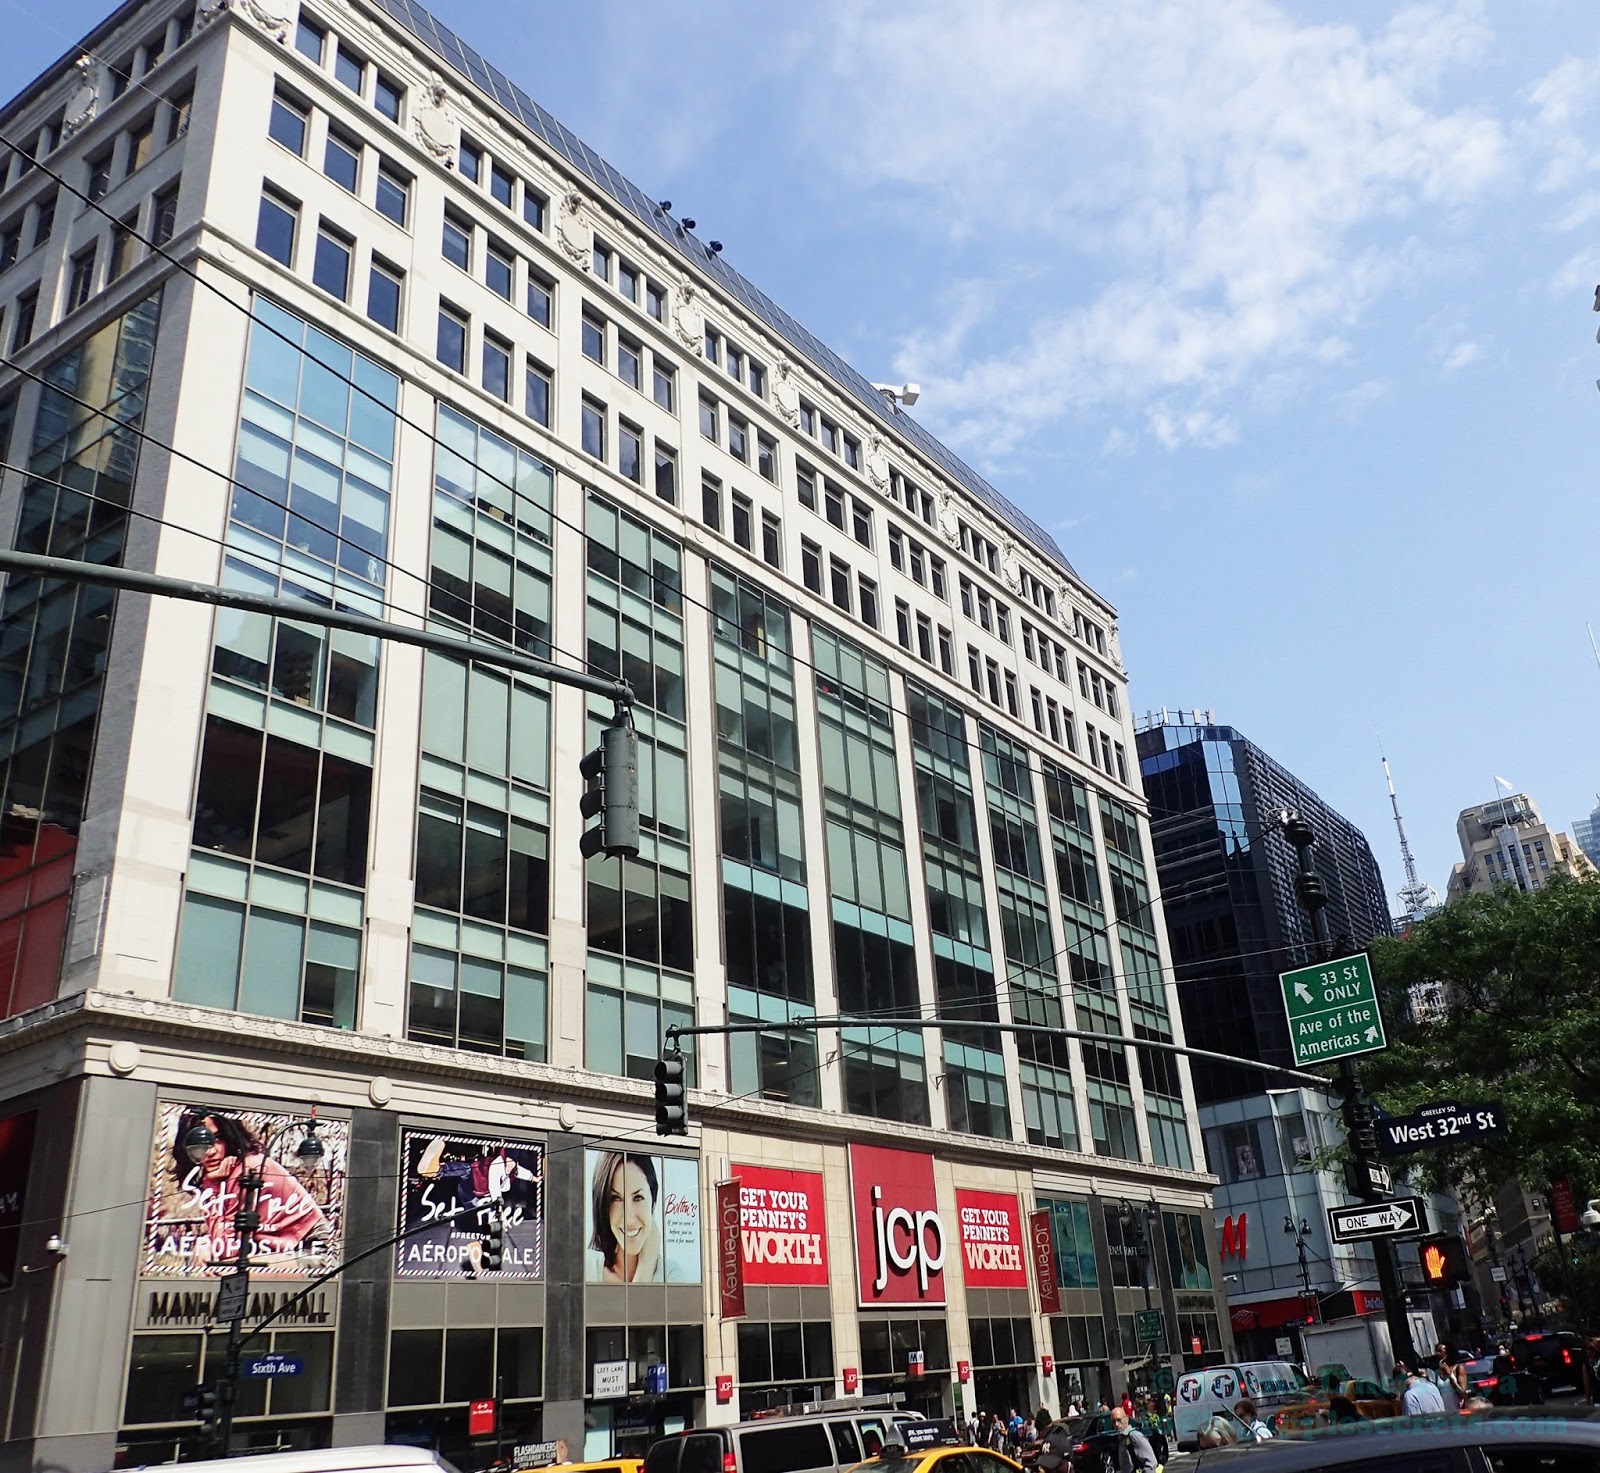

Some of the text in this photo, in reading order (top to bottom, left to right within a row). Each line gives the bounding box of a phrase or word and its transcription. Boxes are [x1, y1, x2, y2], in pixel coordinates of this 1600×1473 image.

[1320, 965, 1359, 986] 33 St
[1324, 982, 1360, 1002] ONLY
[1299, 1009, 1371, 1036] Ave of the
[1299, 1033, 1360, 1057] Americas
[1421, 1105, 1456, 1116] GREELEY SQ
[1389, 1111, 1497, 1144] West 32nd St
[181, 1165, 315, 1219] Set Free
[740, 1187, 808, 1210] GET YOUR
[421, 1183, 465, 1228] Set
[961, 1207, 1010, 1226] GET YOUR
[740, 1208, 807, 1230] PENNEY'S
[1346, 1210, 1403, 1229] ONE WAY
[874, 1185, 946, 1291] jcp
[962, 1224, 1010, 1242] PENNEY'S
[407, 1240, 534, 1265] AÉROPOALE
[722, 1197, 739, 1300] JCPenney
[740, 1230, 822, 1265] WORTH
[964, 1242, 1022, 1271] WORTH
[1035, 1223, 1054, 1300] JCPenney
[252, 1362, 297, 1374] Sixth Ave
[602, 1375, 619, 1383] MUST
[612, 1385, 625, 1393] LEFT
